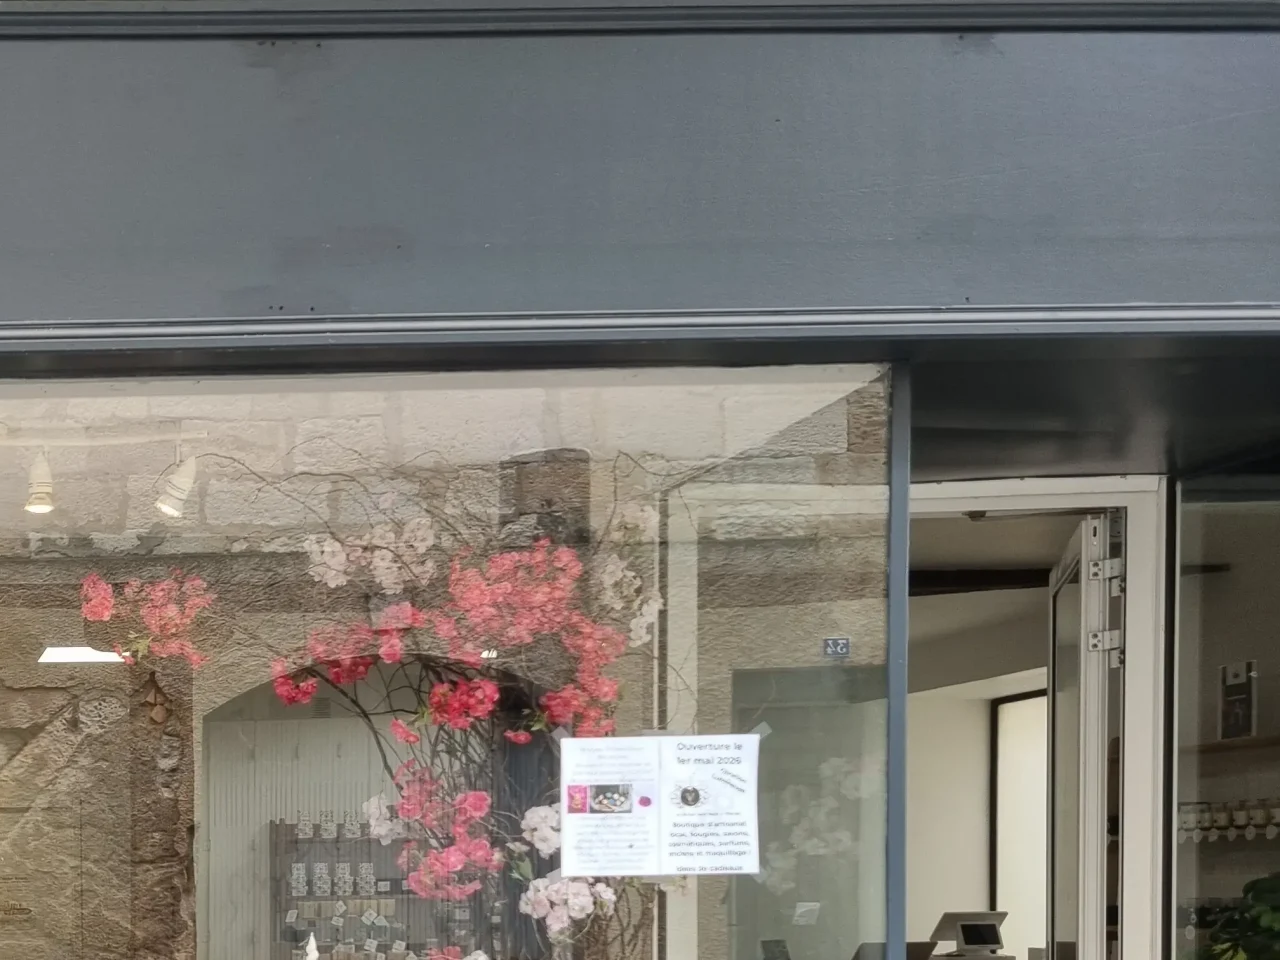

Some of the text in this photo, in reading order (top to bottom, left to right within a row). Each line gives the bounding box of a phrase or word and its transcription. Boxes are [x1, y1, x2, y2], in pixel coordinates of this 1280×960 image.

[676, 742, 743, 751] Ouverture le
[676, 756, 742, 765] 1er mai 2026
